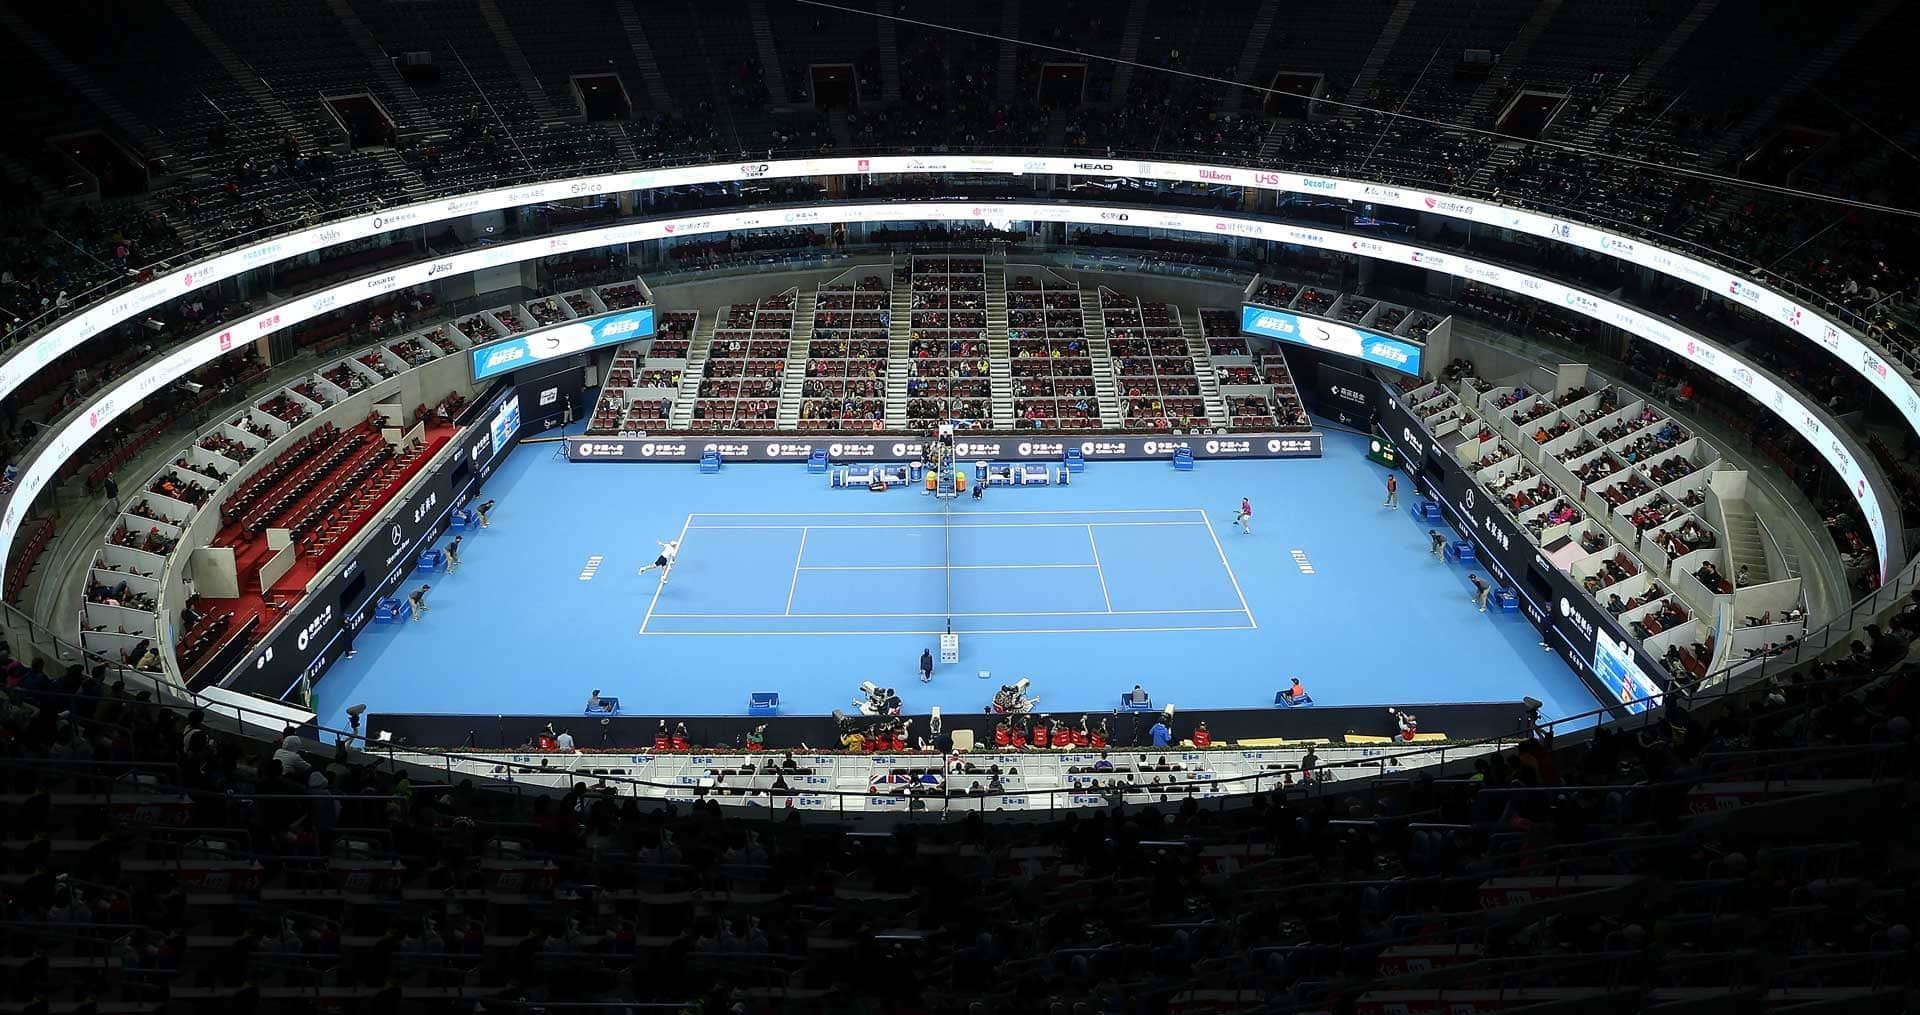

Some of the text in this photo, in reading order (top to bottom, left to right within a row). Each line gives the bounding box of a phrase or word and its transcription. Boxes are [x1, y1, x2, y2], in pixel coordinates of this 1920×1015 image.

[1073, 162, 1114, 171] HEAD
[1199, 169, 1232, 181] Wilson
[1303, 178, 1337, 190] DecoTurf
